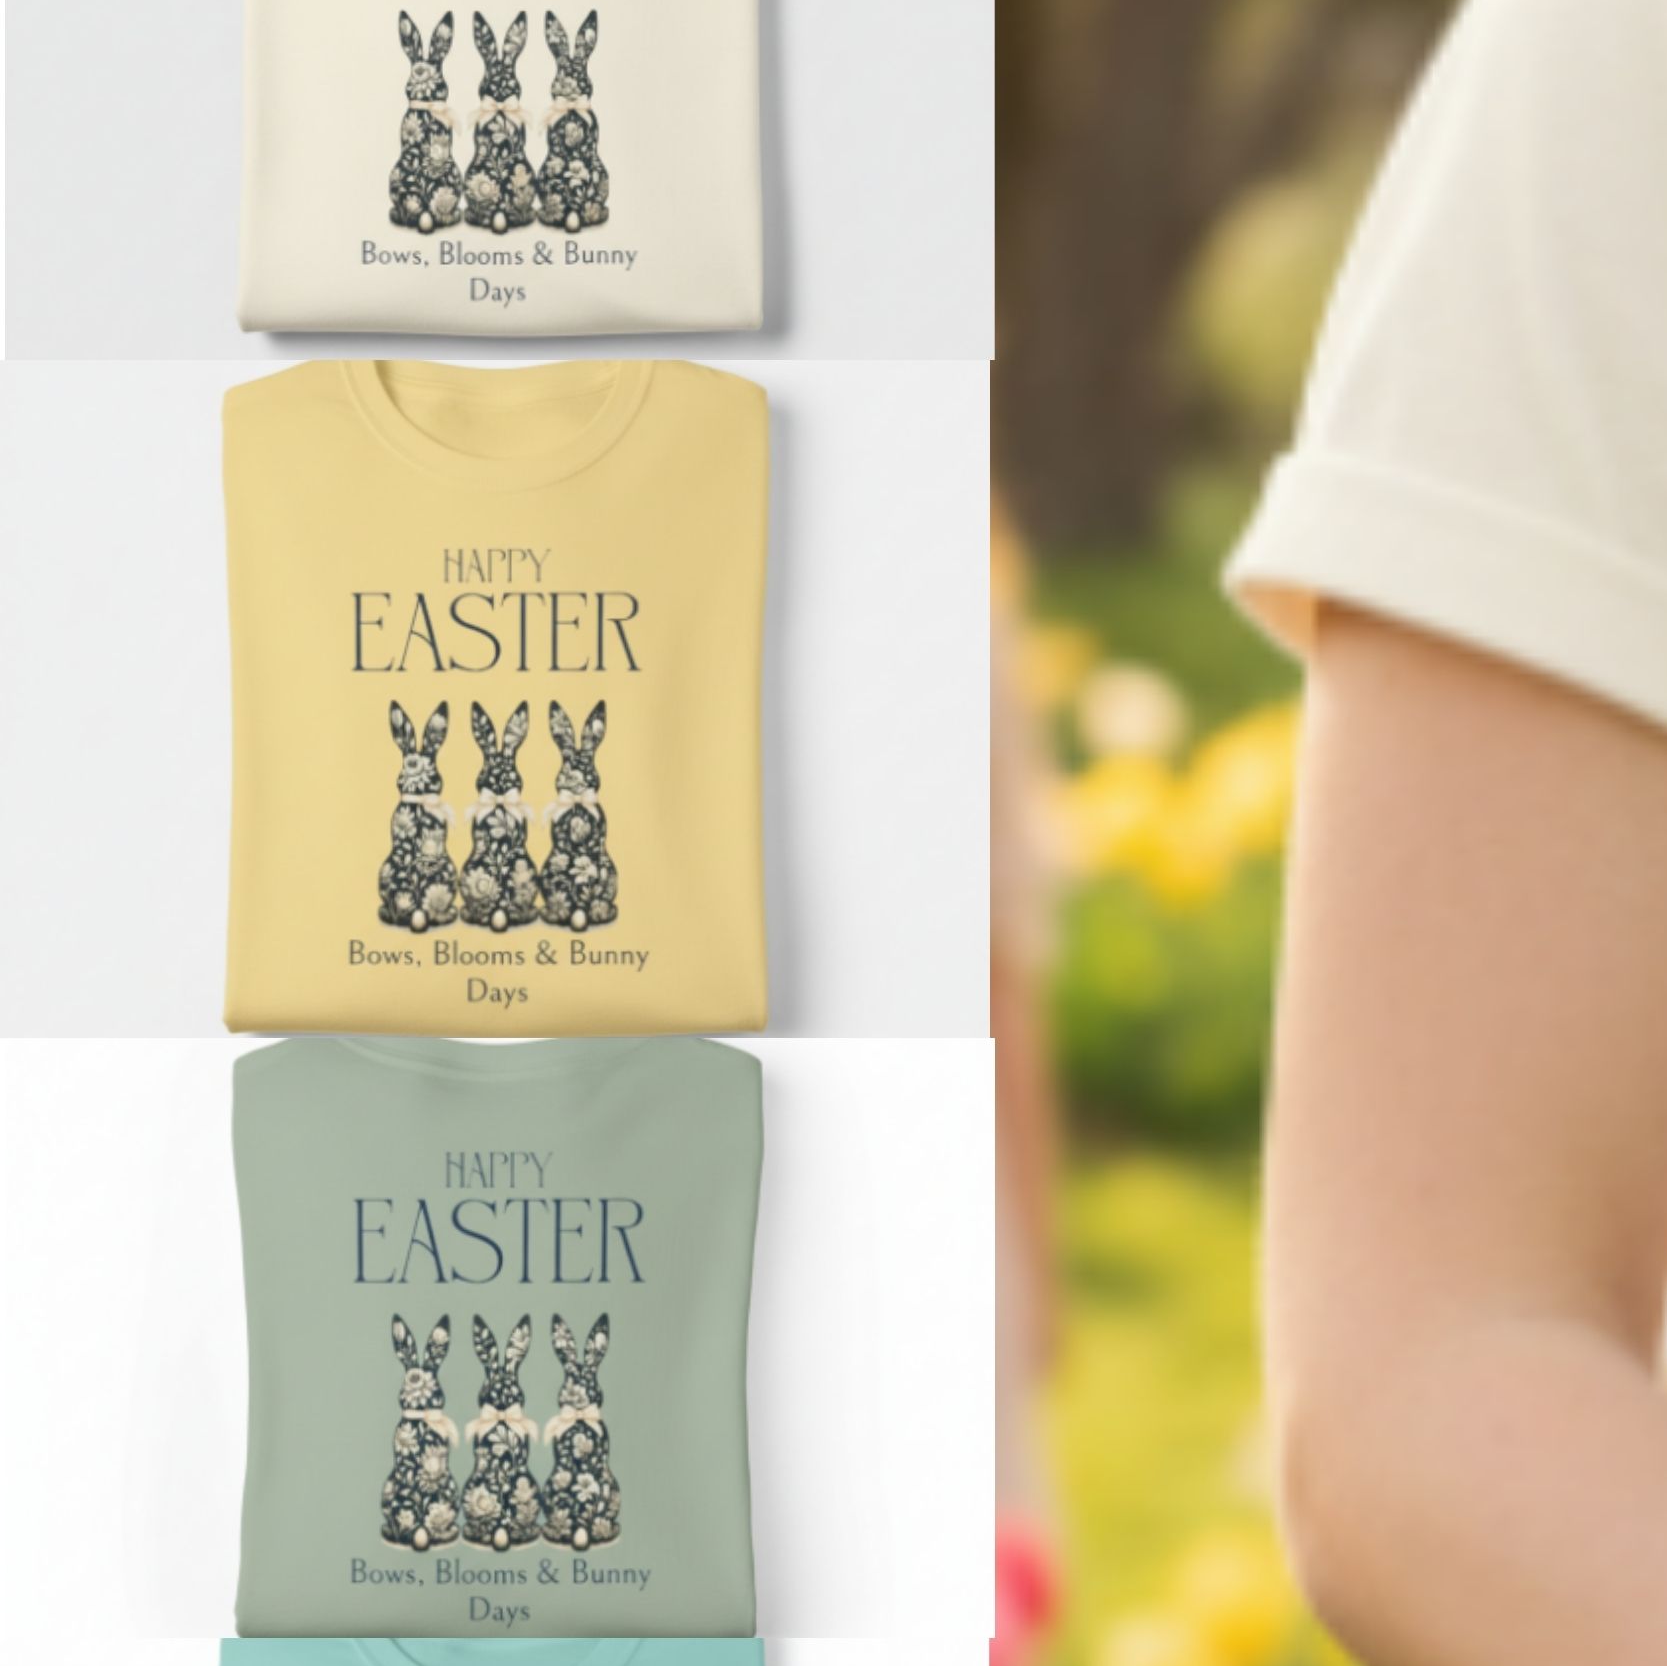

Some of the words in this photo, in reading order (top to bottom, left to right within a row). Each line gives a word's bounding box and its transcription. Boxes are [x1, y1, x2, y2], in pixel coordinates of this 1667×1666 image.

[361, 239, 429, 269] Bows,
[439, 240, 525, 266] Blooms
[532, 240, 554, 266] &
[564, 239, 638, 272] Bunny
[469, 276, 527, 309] Days
[443, 548, 549, 584] HAPPY
[352, 591, 641, 673] EASTER
[348, 939, 423, 969] Bows,
[433, 939, 526, 966] Blooms
[534, 939, 558, 966] &
[570, 938, 650, 973] Bunny
[466, 977, 529, 1010] Days
[445, 1150, 553, 1189] HAPPY
[354, 1197, 646, 1284] EASTER
[350, 1557, 425, 1588] Bows,
[435, 1557, 528, 1586] Blooms
[536, 1558, 561, 1586] &
[572, 1557, 652, 1592] Bunny
[468, 1595, 531, 1630] Days
